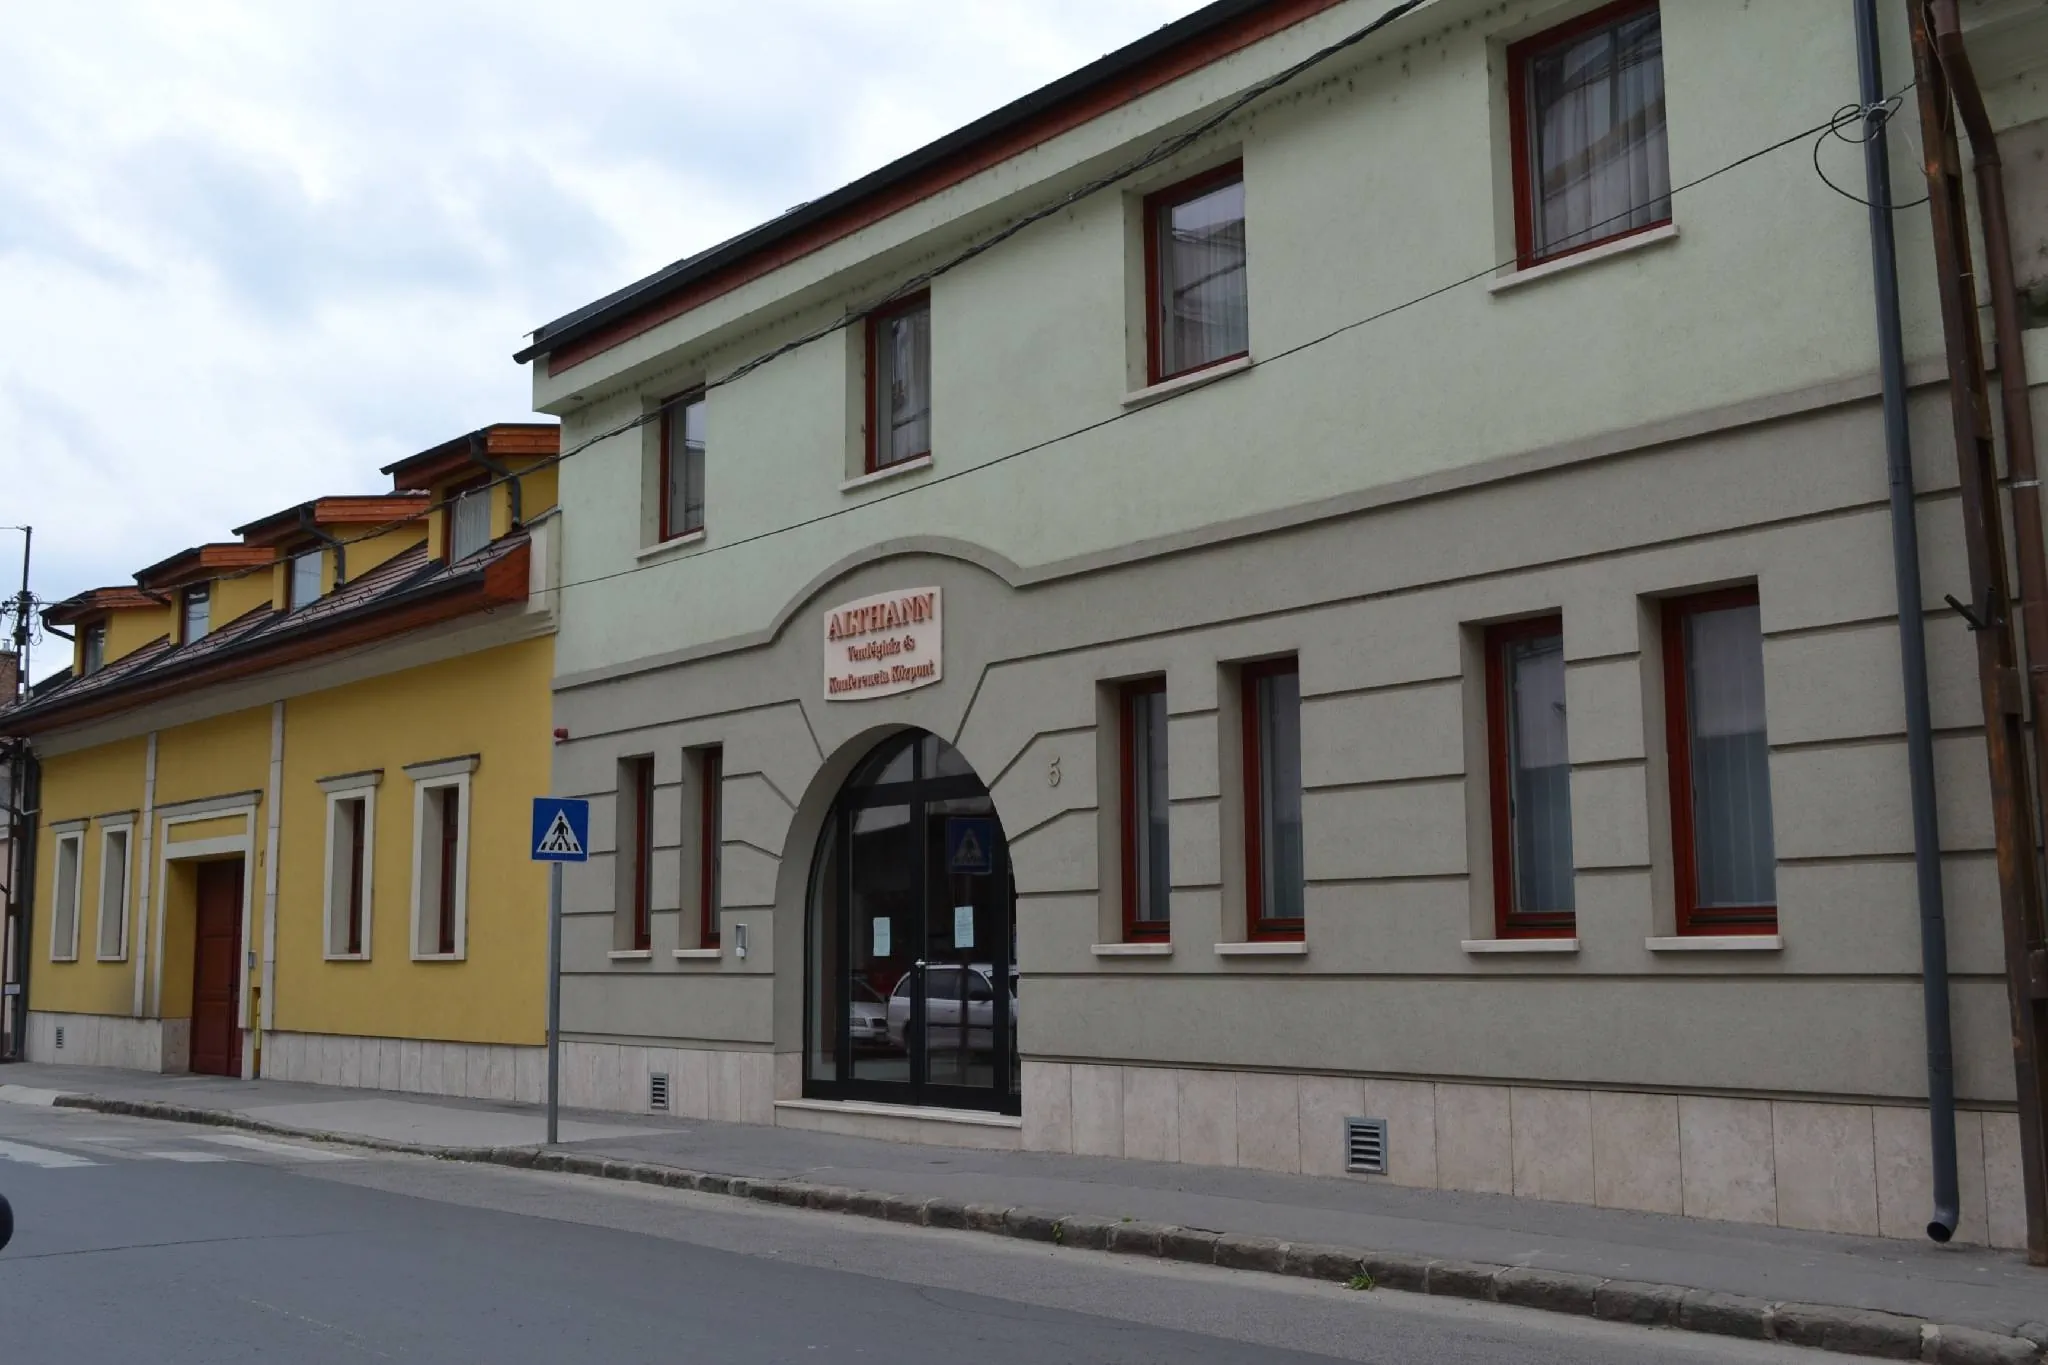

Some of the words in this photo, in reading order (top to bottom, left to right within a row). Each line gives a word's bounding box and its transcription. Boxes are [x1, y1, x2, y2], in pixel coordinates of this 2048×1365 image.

[829, 592, 935, 641] ALTHANN
[848, 638, 901, 662] Vendégház
[903, 635, 915, 651] és
[829, 670, 890, 694] Konferencia
[891, 659, 935, 684] Központ
[1048, 755, 1061, 788] 5
